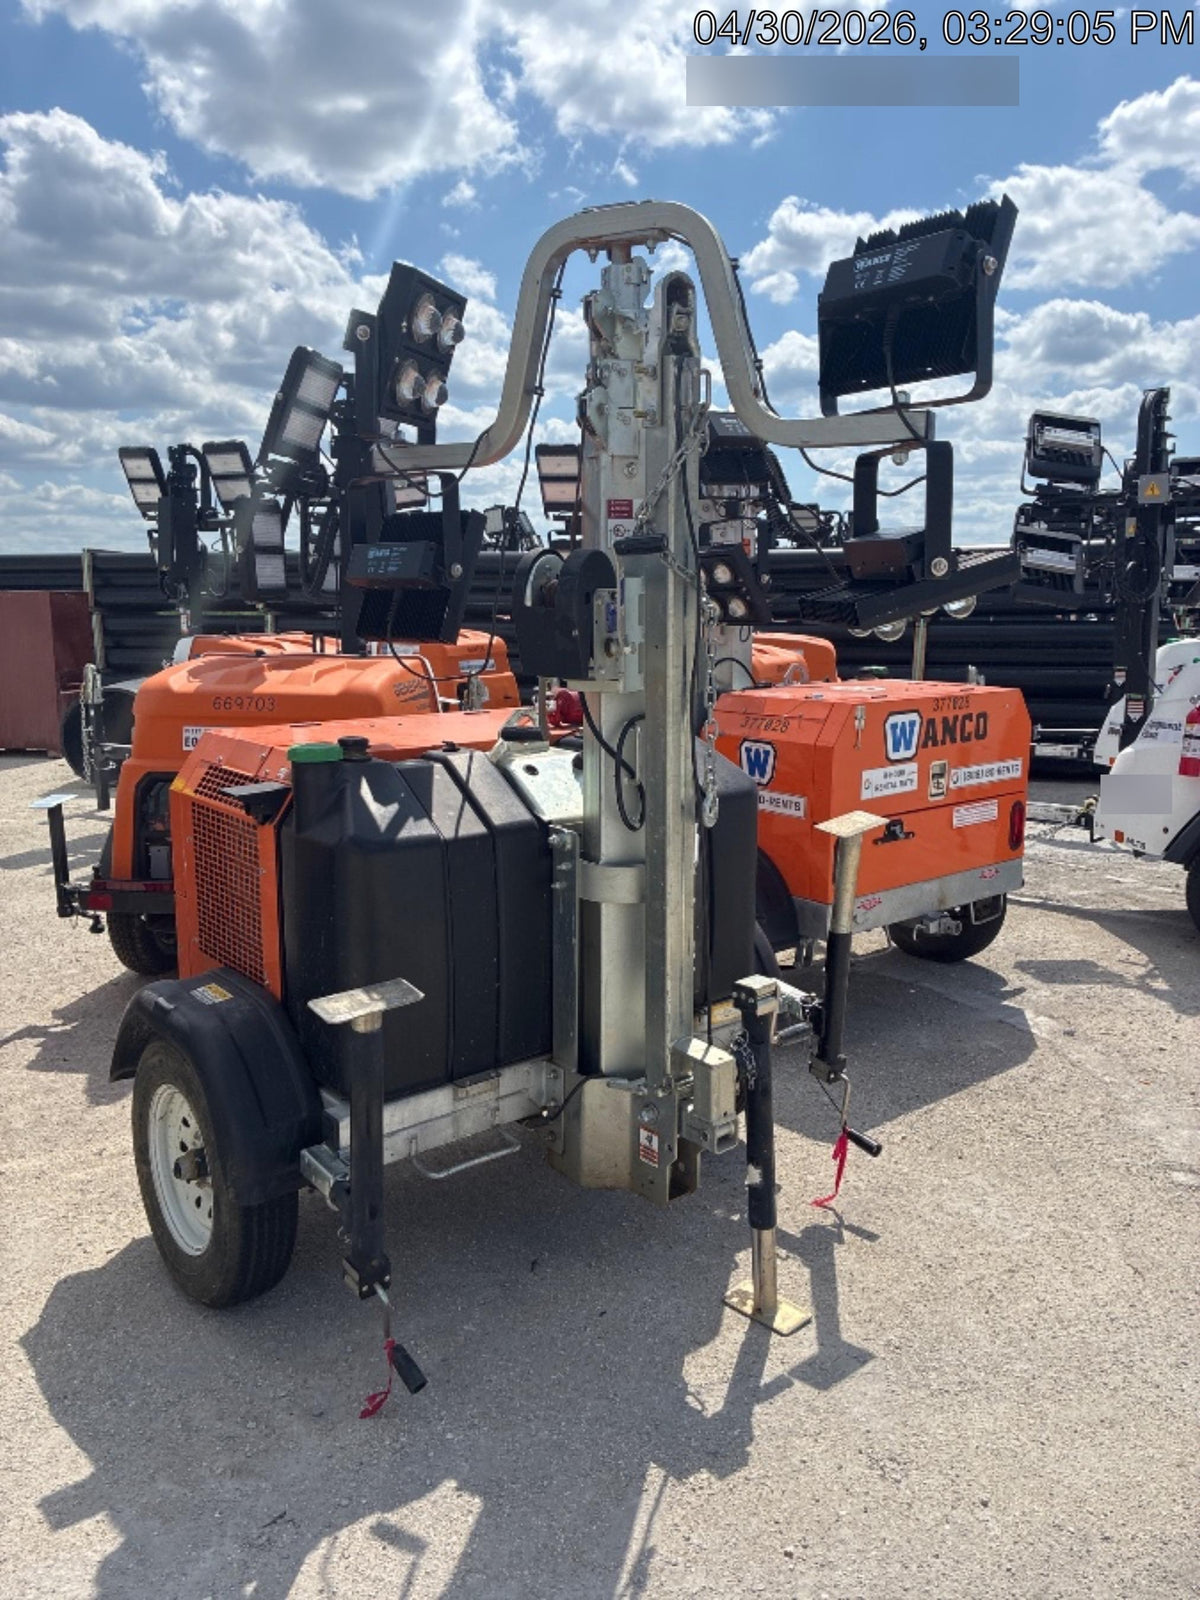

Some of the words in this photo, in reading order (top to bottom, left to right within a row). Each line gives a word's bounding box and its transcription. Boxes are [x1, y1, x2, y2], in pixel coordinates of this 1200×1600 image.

[212, 695, 277, 712] 669703
[888, 711, 989, 754] WANCO
[743, 745, 772, 780] W
